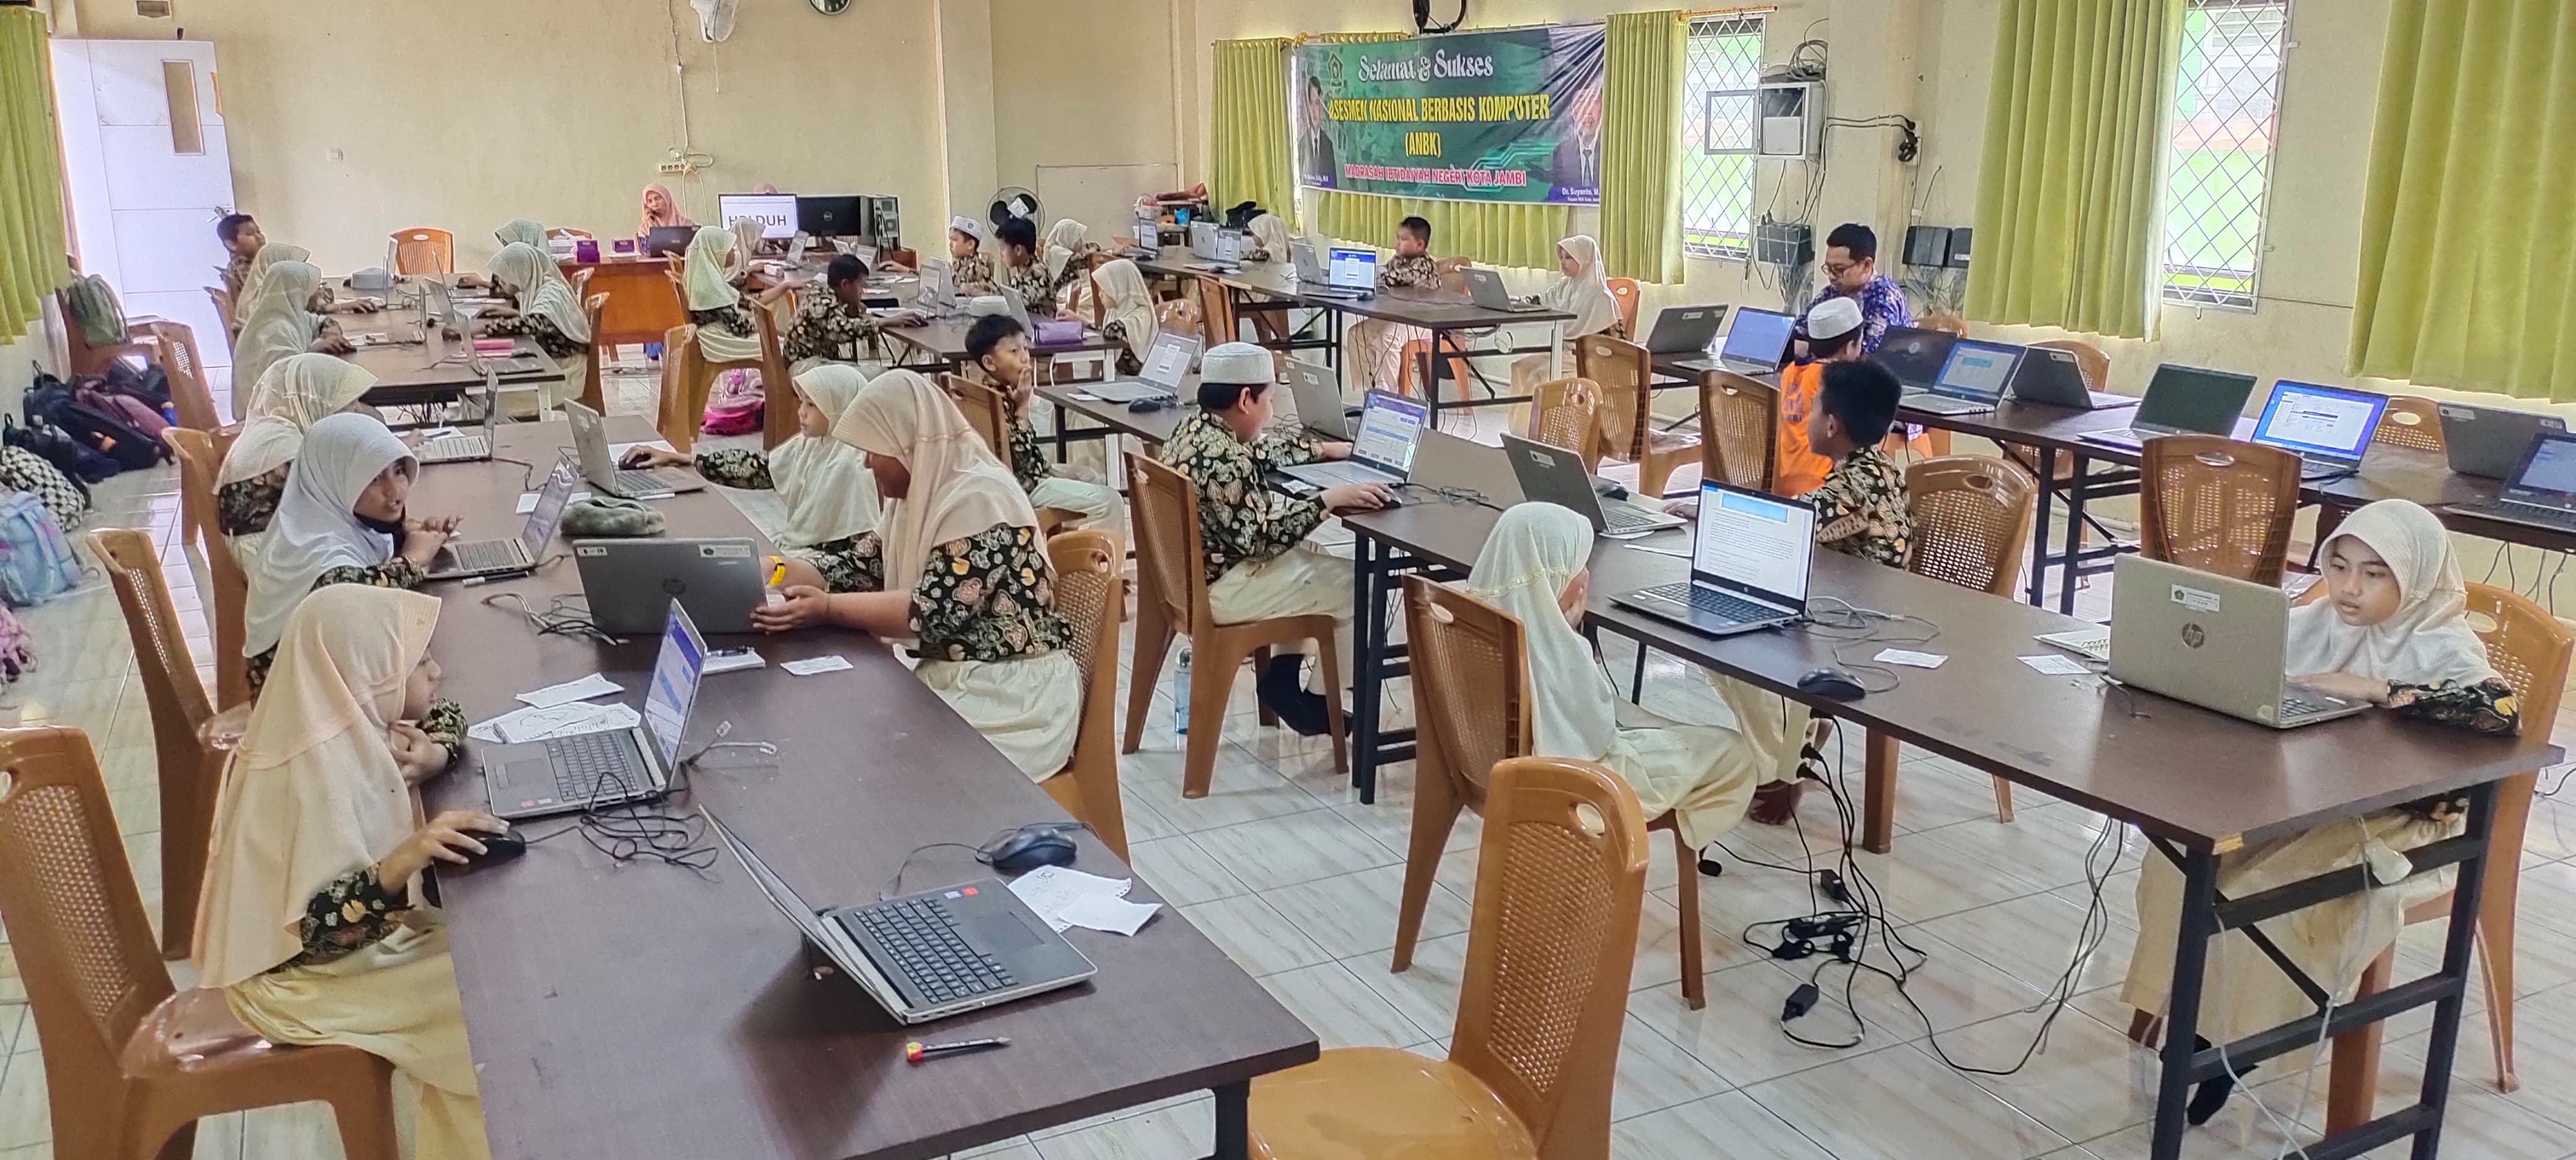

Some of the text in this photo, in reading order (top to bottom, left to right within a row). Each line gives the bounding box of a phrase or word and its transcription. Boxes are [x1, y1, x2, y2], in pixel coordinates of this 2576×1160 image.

[1358, 48, 1494, 82] Selamat & Sukses
[1329, 94, 1550, 122] ASESMEN NASIONAL BERBASIS KOMPUTER
[1405, 132, 1442, 158] (ANBK)
[1344, 163, 1385, 181] MADRASAH
[1385, 166, 1430, 183] IBTIDAIYAH
[1432, 168, 1466, 184] NEGERI
[1466, 170, 1492, 186] KOTA
[1494, 170, 1526, 187] JAMBI
